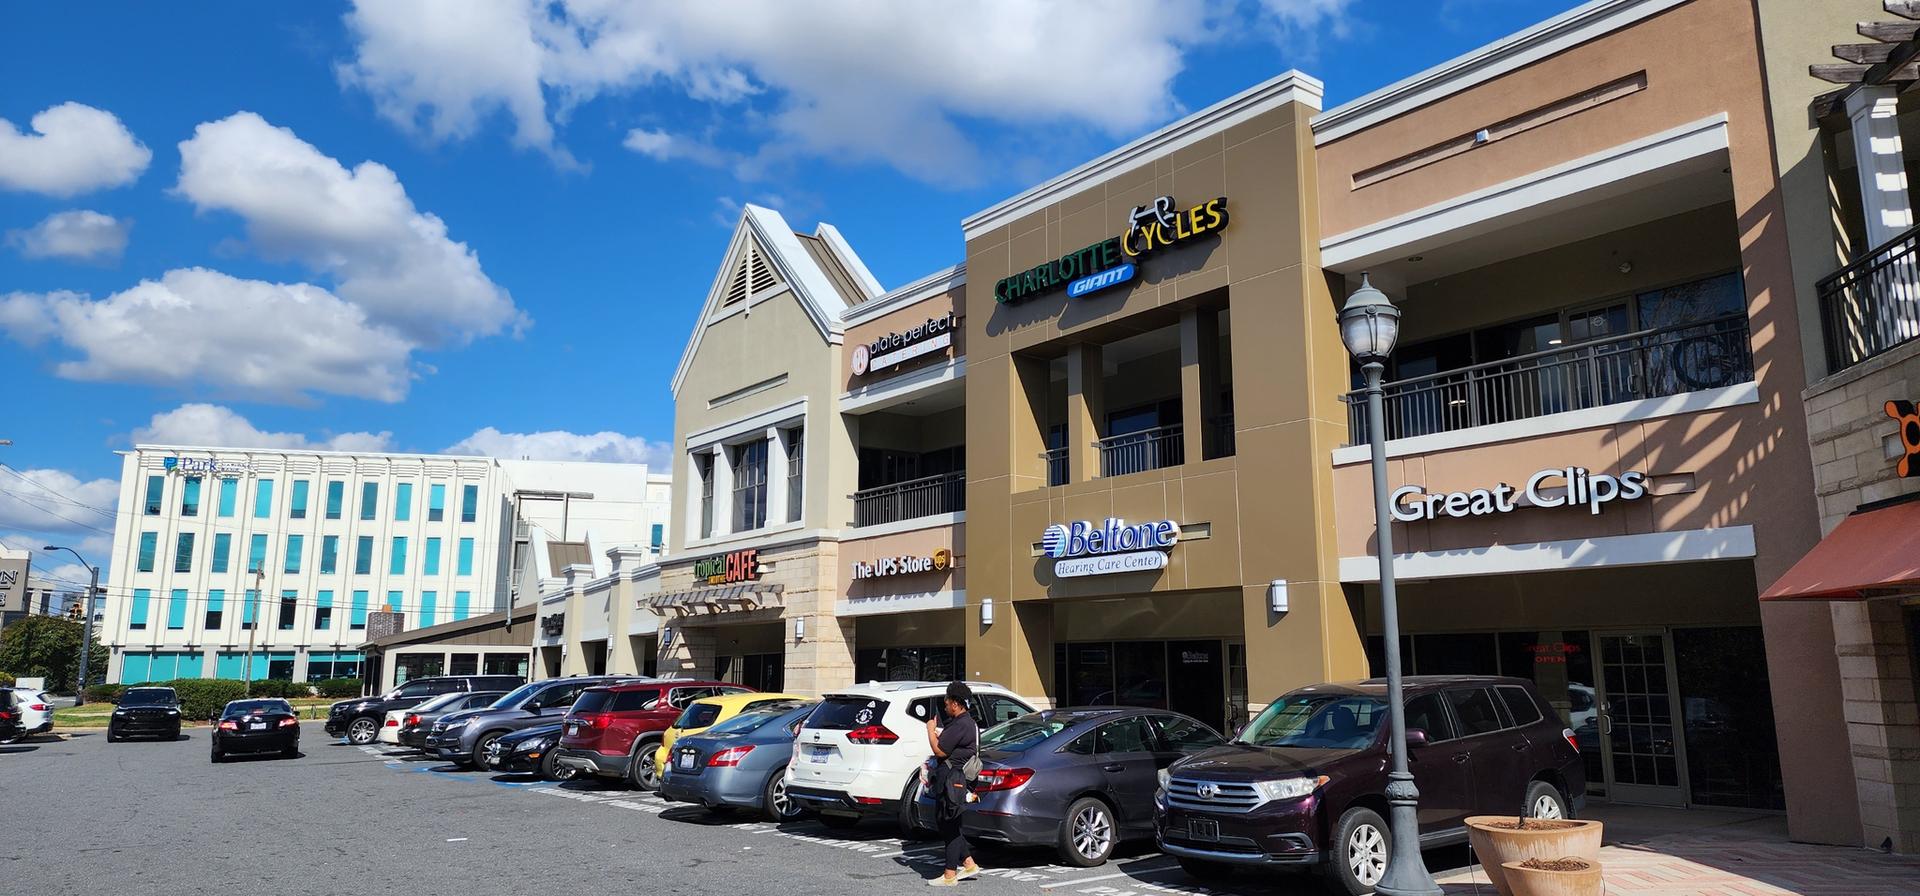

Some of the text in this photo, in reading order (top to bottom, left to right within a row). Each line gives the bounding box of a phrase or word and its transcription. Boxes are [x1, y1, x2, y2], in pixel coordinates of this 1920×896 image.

[994, 198, 1224, 304] CHARLOTTE CYCLES
[1072, 265, 1130, 295] GIANT
[869, 313, 952, 359] plate perfect
[871, 334, 950, 369] CATERING
[182, 456, 218, 474] Park
[1389, 466, 1646, 522] Great Clips
[1068, 517, 1174, 557] Beltone
[726, 549, 757, 582] CAFE
[852, 555, 932, 579] The UPS Store
[1058, 555, 1160, 575] Hearing Care Center
[1535, 655, 1567, 664] OPEN
